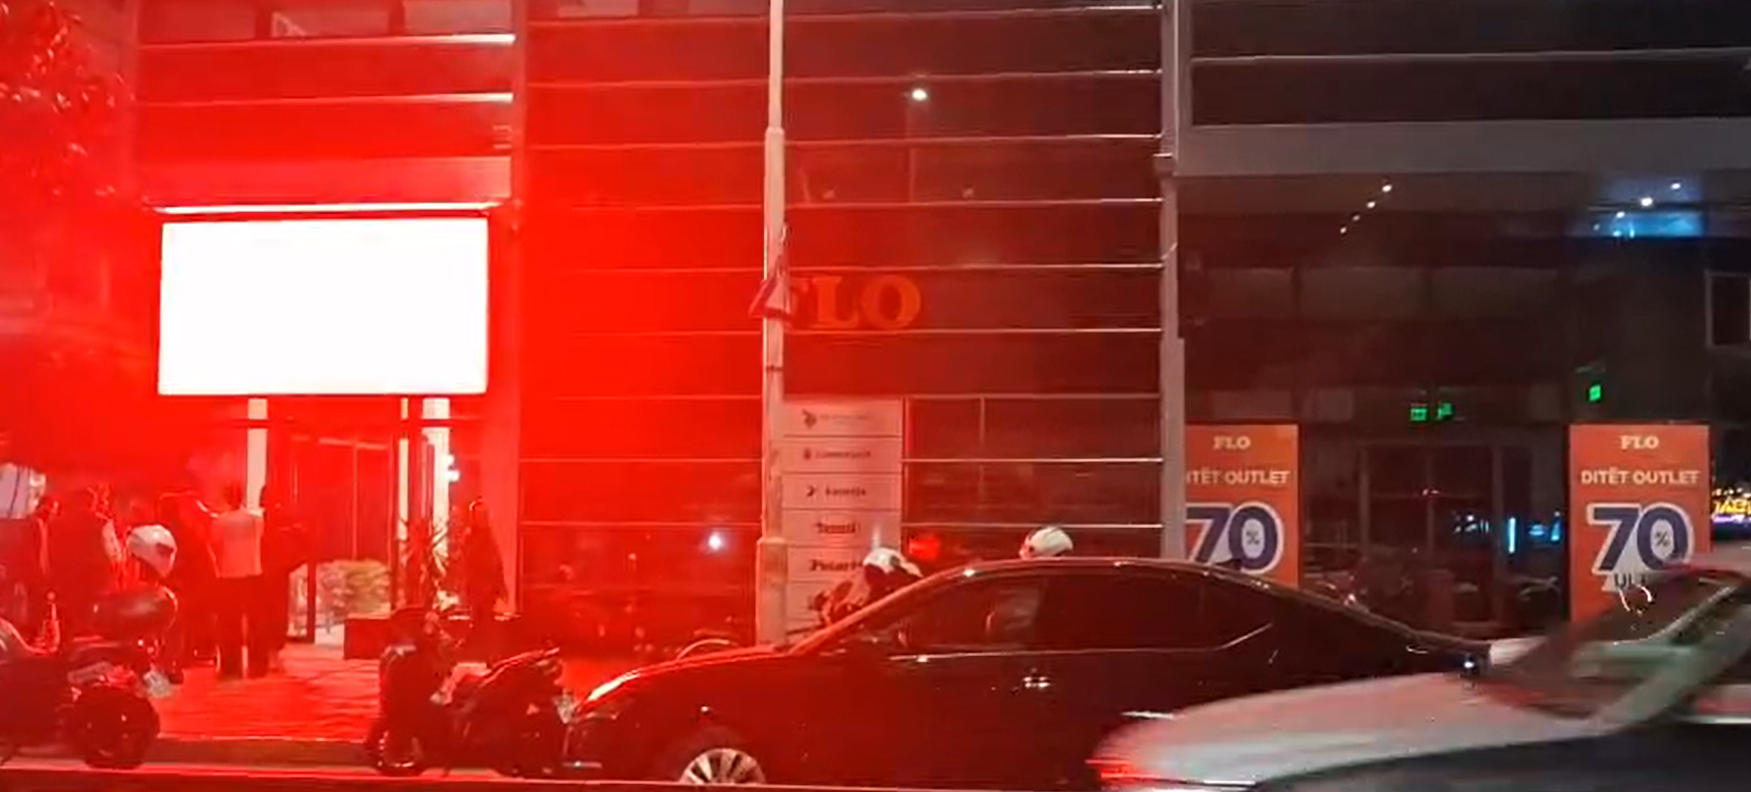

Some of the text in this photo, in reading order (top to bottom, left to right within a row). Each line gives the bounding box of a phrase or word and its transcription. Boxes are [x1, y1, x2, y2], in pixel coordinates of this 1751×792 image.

[1213, 435, 1251, 450] FLO
[1621, 435, 1659, 449] FLO
[1224, 469, 1290, 485] OUTLET
[1633, 470, 1700, 485] OUTLET
[1185, 501, 1284, 575] 70
[1586, 502, 1694, 576] 70
